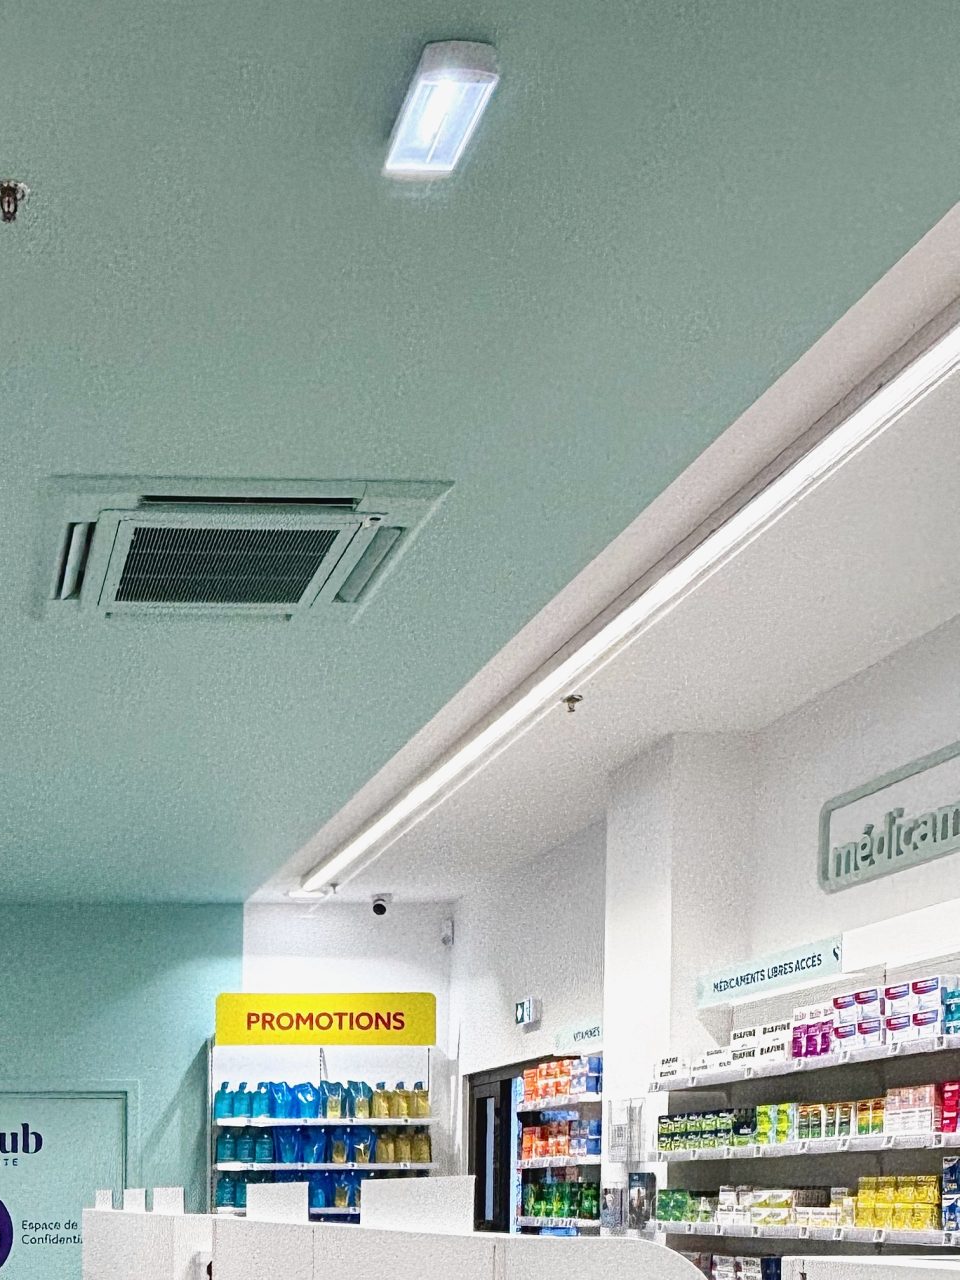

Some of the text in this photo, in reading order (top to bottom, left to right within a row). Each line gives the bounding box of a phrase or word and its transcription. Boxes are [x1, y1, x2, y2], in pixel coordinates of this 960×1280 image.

[767, 961, 794, 980] LIBRES
[246, 1011, 406, 1031] PROMOTIONS
[22, 1219, 78, 1232] Espace de
[22, 1234, 83, 1245] Confidenti
